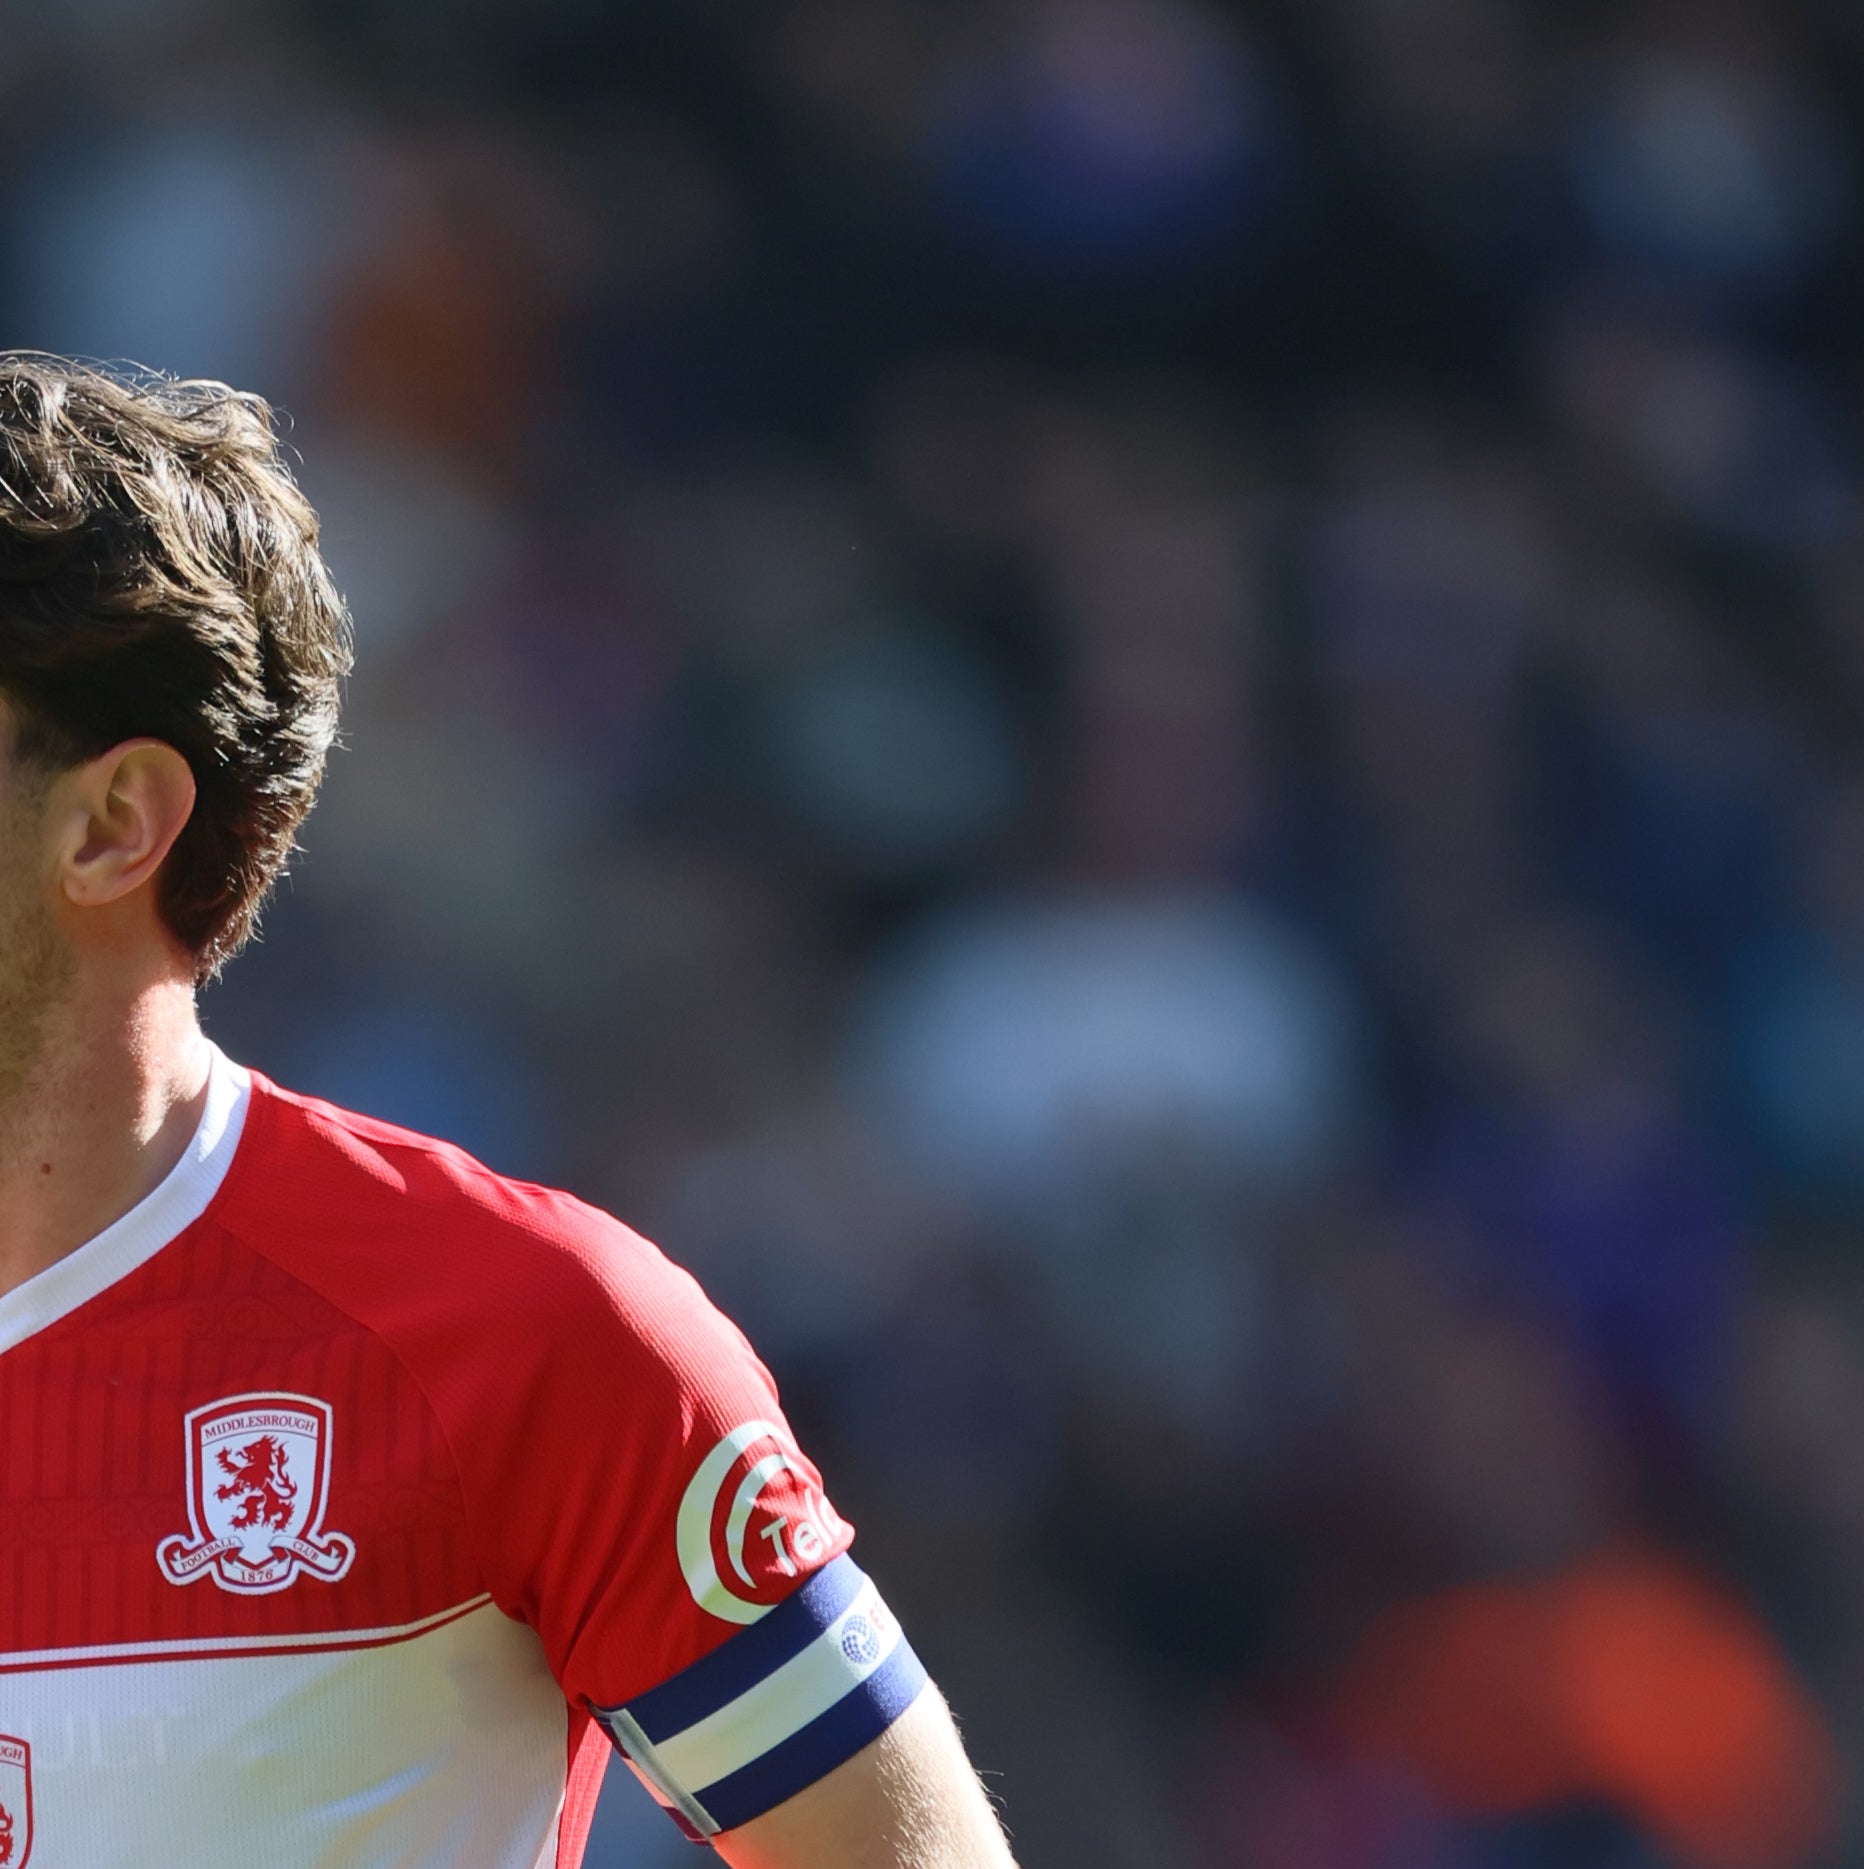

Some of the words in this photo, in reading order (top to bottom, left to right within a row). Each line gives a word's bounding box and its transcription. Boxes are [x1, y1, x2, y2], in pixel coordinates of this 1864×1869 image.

[204, 1415, 316, 1439] MIDDLESBROUGH
[181, 1538, 236, 1571] FOOTBALL
[292, 1540, 320, 1562] CLUB
[240, 1569, 274, 1583] 1876
